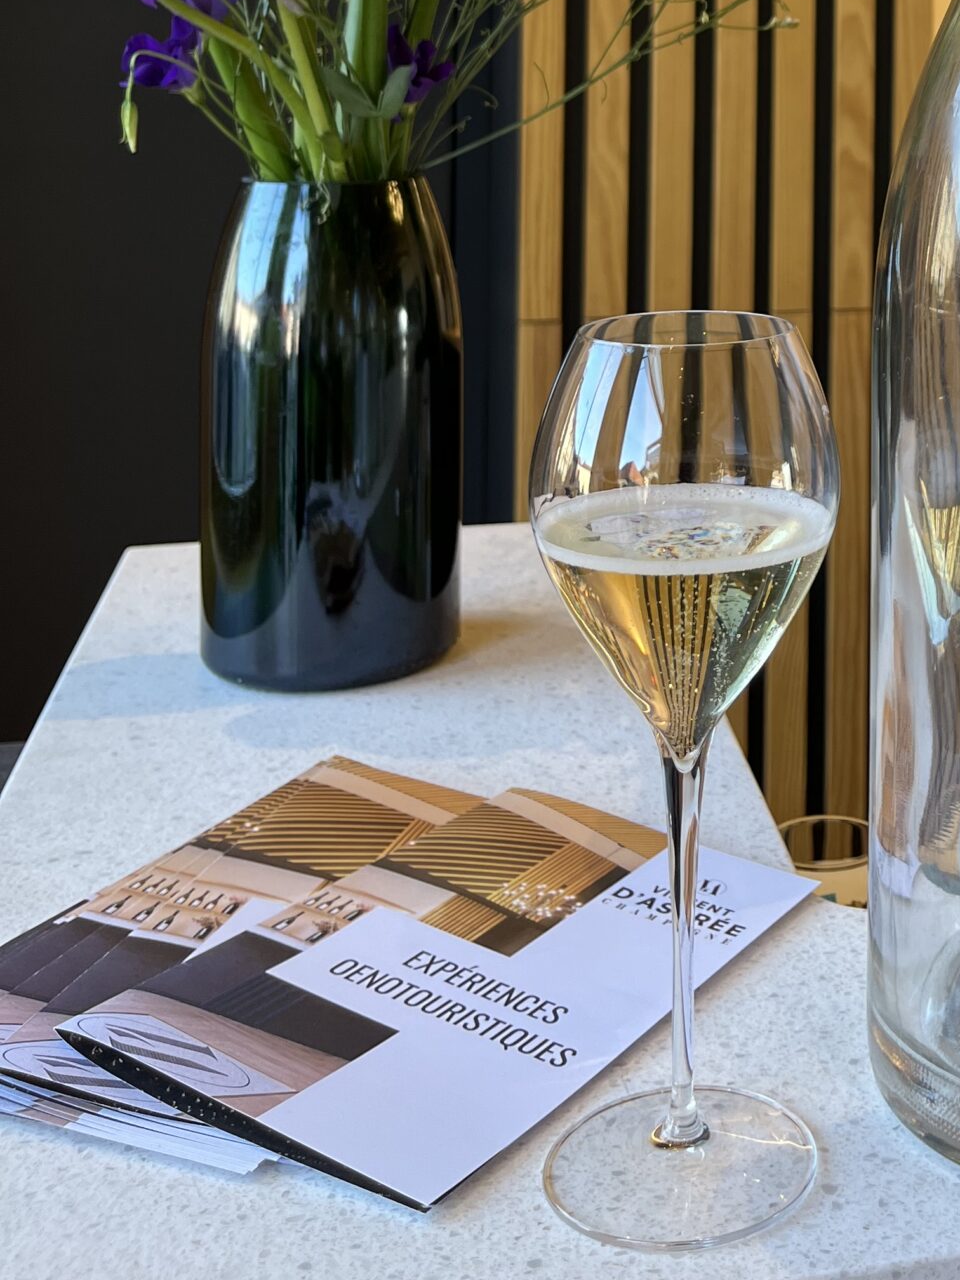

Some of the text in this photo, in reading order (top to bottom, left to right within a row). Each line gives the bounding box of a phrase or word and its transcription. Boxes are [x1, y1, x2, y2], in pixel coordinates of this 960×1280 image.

[601, 897, 734, 946] CHAMPGNE
[612, 886, 747, 938] D'ASRÉE
[653, 885, 735, 917] VIENT
[329, 957, 578, 1069] OENOTOURISTIQUES
[402, 949, 569, 1025] EXPÉRIENCES
